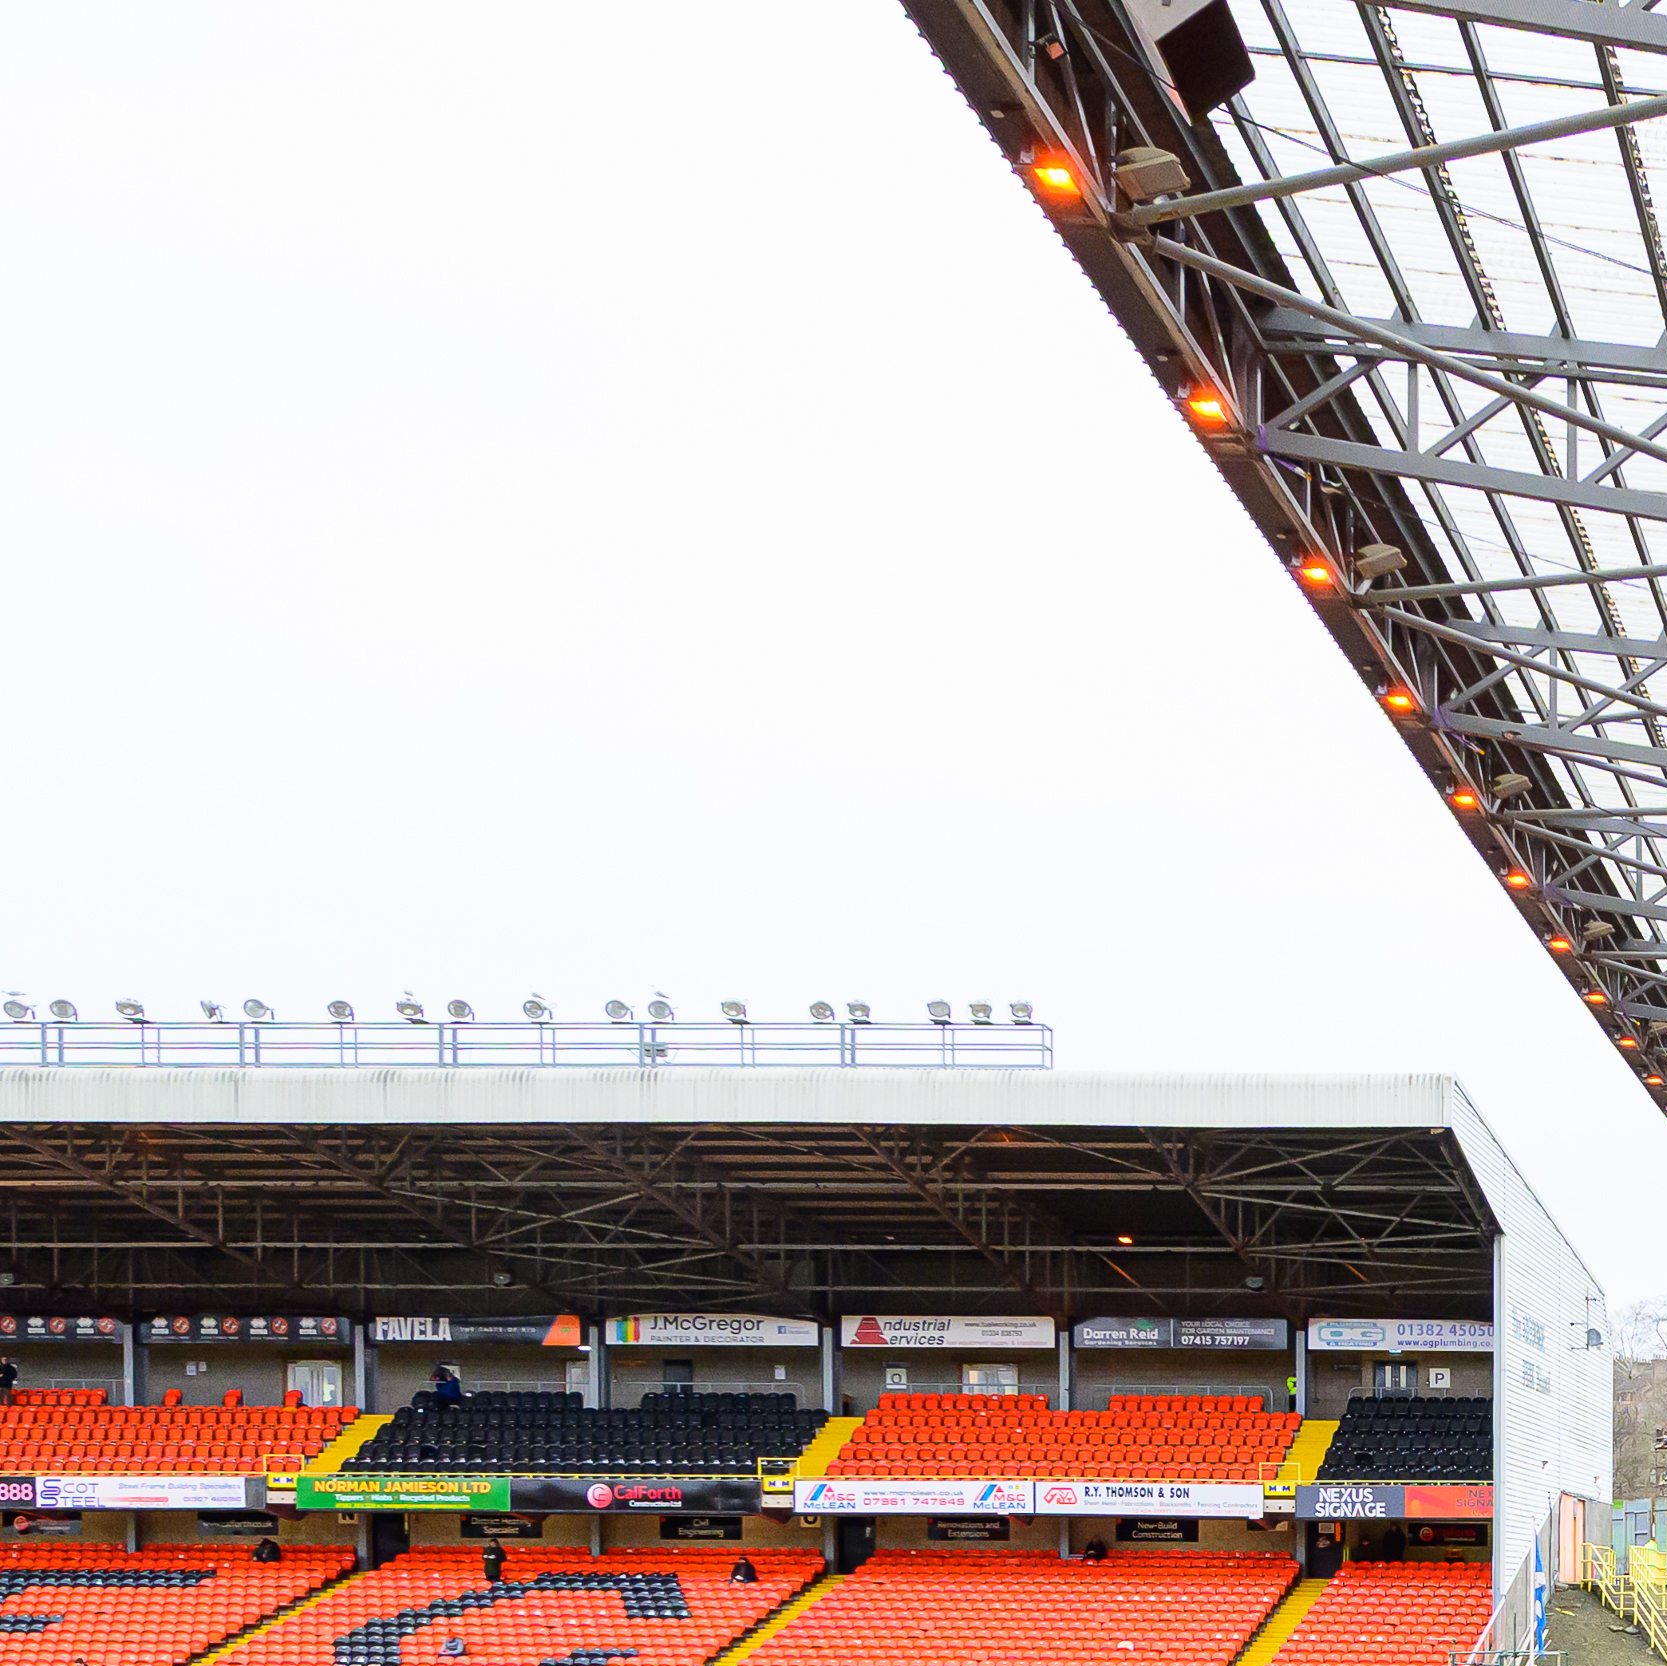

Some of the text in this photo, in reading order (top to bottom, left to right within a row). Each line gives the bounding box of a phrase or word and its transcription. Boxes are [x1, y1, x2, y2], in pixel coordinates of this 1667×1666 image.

[375, 1316, 452, 1341] FAVELA
[650, 1315, 764, 1336] J.McGregor
[1083, 1327, 1158, 1340] Darren Reid
[1397, 1324, 1444, 1337] 01382
[650, 1335, 764, 1343] PAINTER DECORATOR
[1181, 1336, 1250, 1346] 07415 757197
[1434, 1372, 1445, 1385] P
[168, 1483, 197, 1491] Building
[313, 1480, 492, 1494] NORMAN JAMIESON LTD
[613, 1484, 682, 1500] CalForth
[1084, 1486, 1190, 1499] R.Y. THOMSON & SON
[1318, 1487, 1374, 1502] NEXUS
[400, 1494, 435, 1502] Recycled
[436, 1494, 470, 1502] Products
[823, 1493, 856, 1502] M&C
[863, 1498, 965, 1506] 07961 747649
[993, 1493, 1026, 1502] M&C
[803, 1502, 856, 1510] McLEAN
[973, 1502, 1027, 1510] McLEAN
[1315, 1502, 1386, 1518] SIGNAGE
[936, 1521, 1000, 1530] Renovations and
[1137, 1521, 1178, 1530] New-Build
[678, 1527, 724, 1538] Engineering
[947, 1529, 990, 1538] Extensions
[1131, 1530, 1183, 1539] Construction
